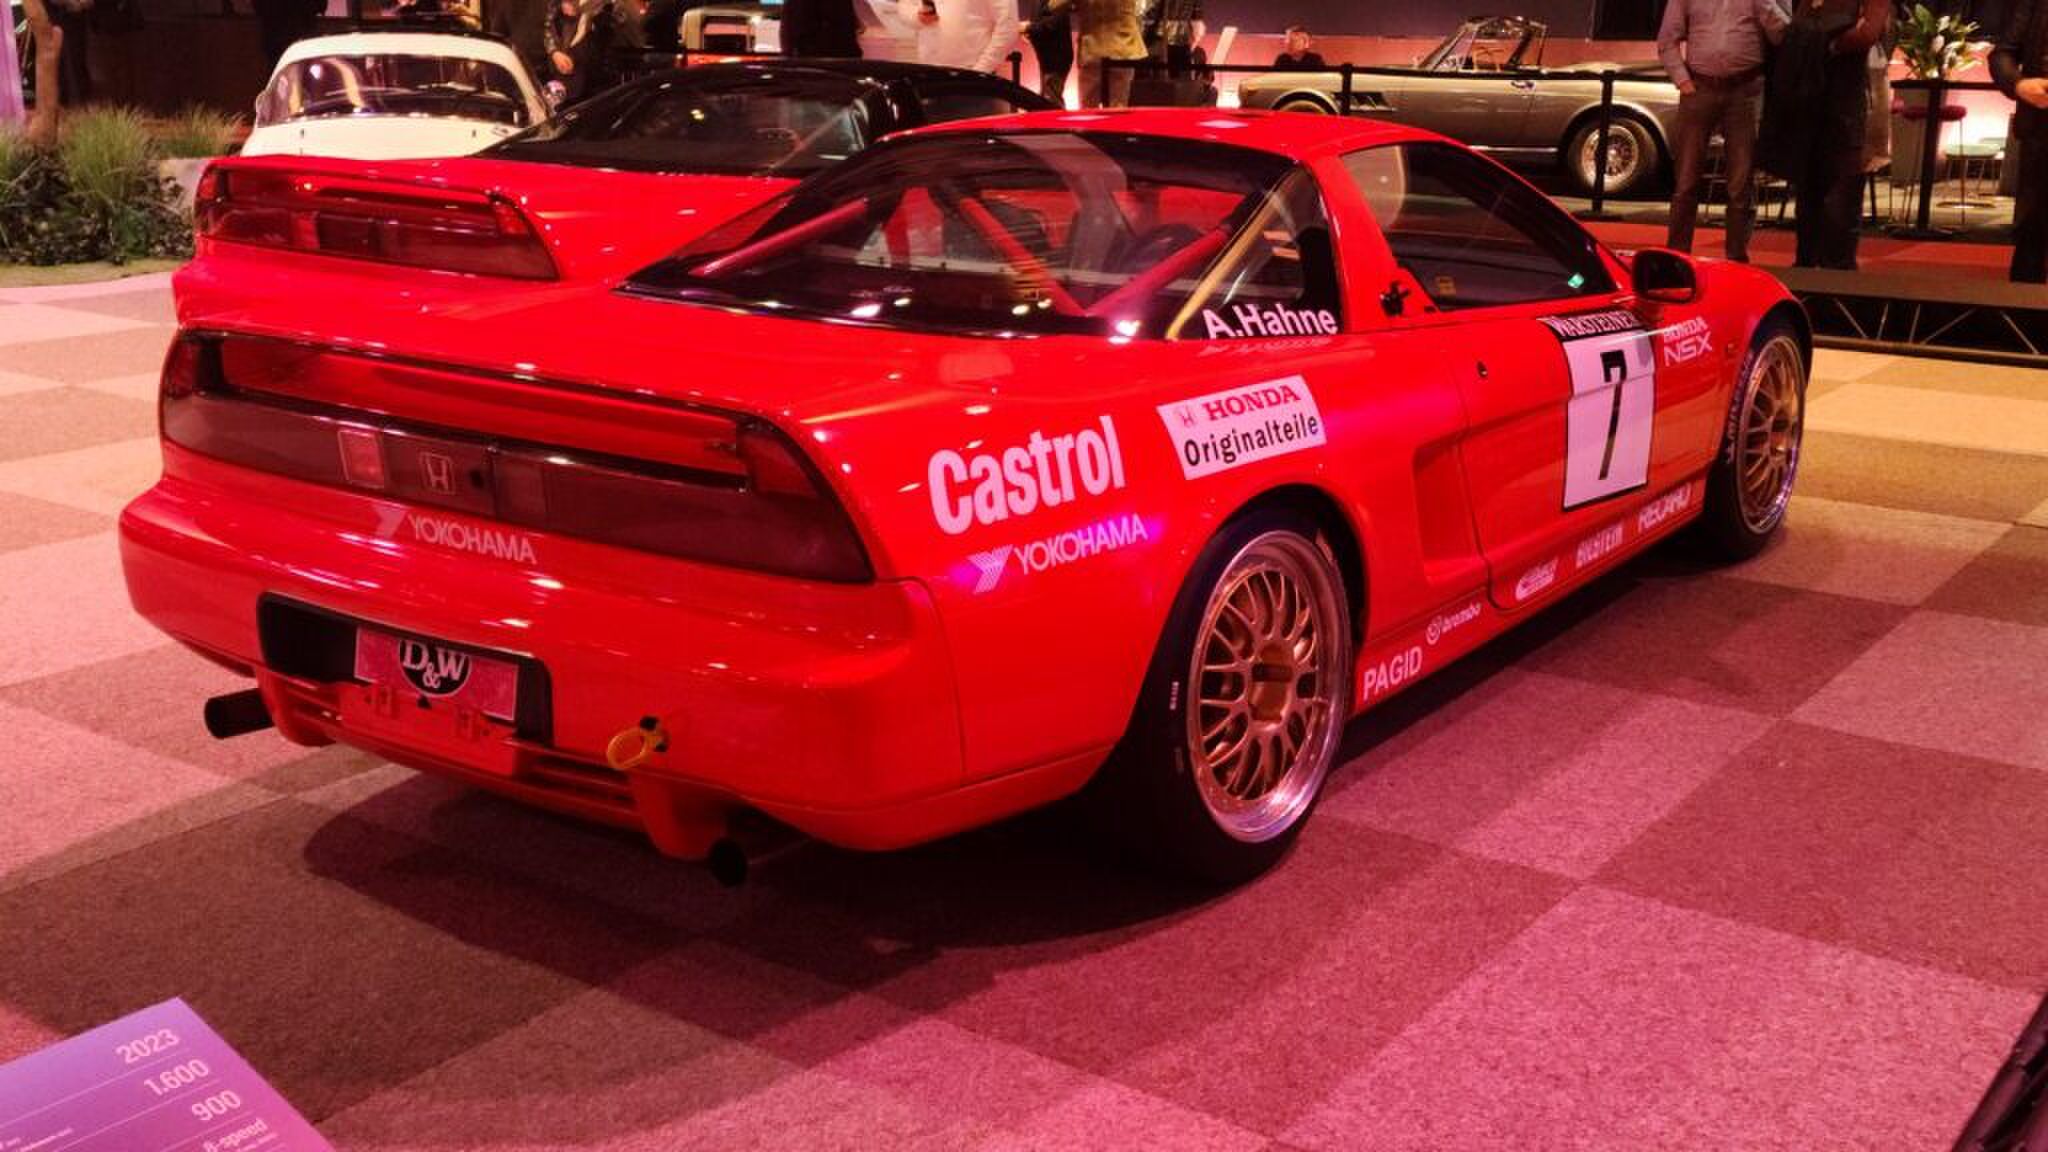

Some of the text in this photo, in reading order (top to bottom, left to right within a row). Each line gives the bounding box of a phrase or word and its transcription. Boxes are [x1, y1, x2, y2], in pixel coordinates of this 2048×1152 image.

[1202, 303, 1338, 340] A.Hahne
[1664, 332, 1712, 366] NSX
[1203, 385, 1301, 421] HONDA
[1599, 350, 1627, 480] 7
[1184, 413, 1318, 466] Originalteile
[928, 415, 1125, 535] Castrol
[408, 514, 536, 565] YOKOHAMA
[1014, 514, 1148, 575] YOKOHAMA
[1363, 646, 1422, 701] PAGID
[115, 1028, 180, 1064] 2023
[143, 1059, 209, 1096] 1.600
[191, 1090, 241, 1121] 900
